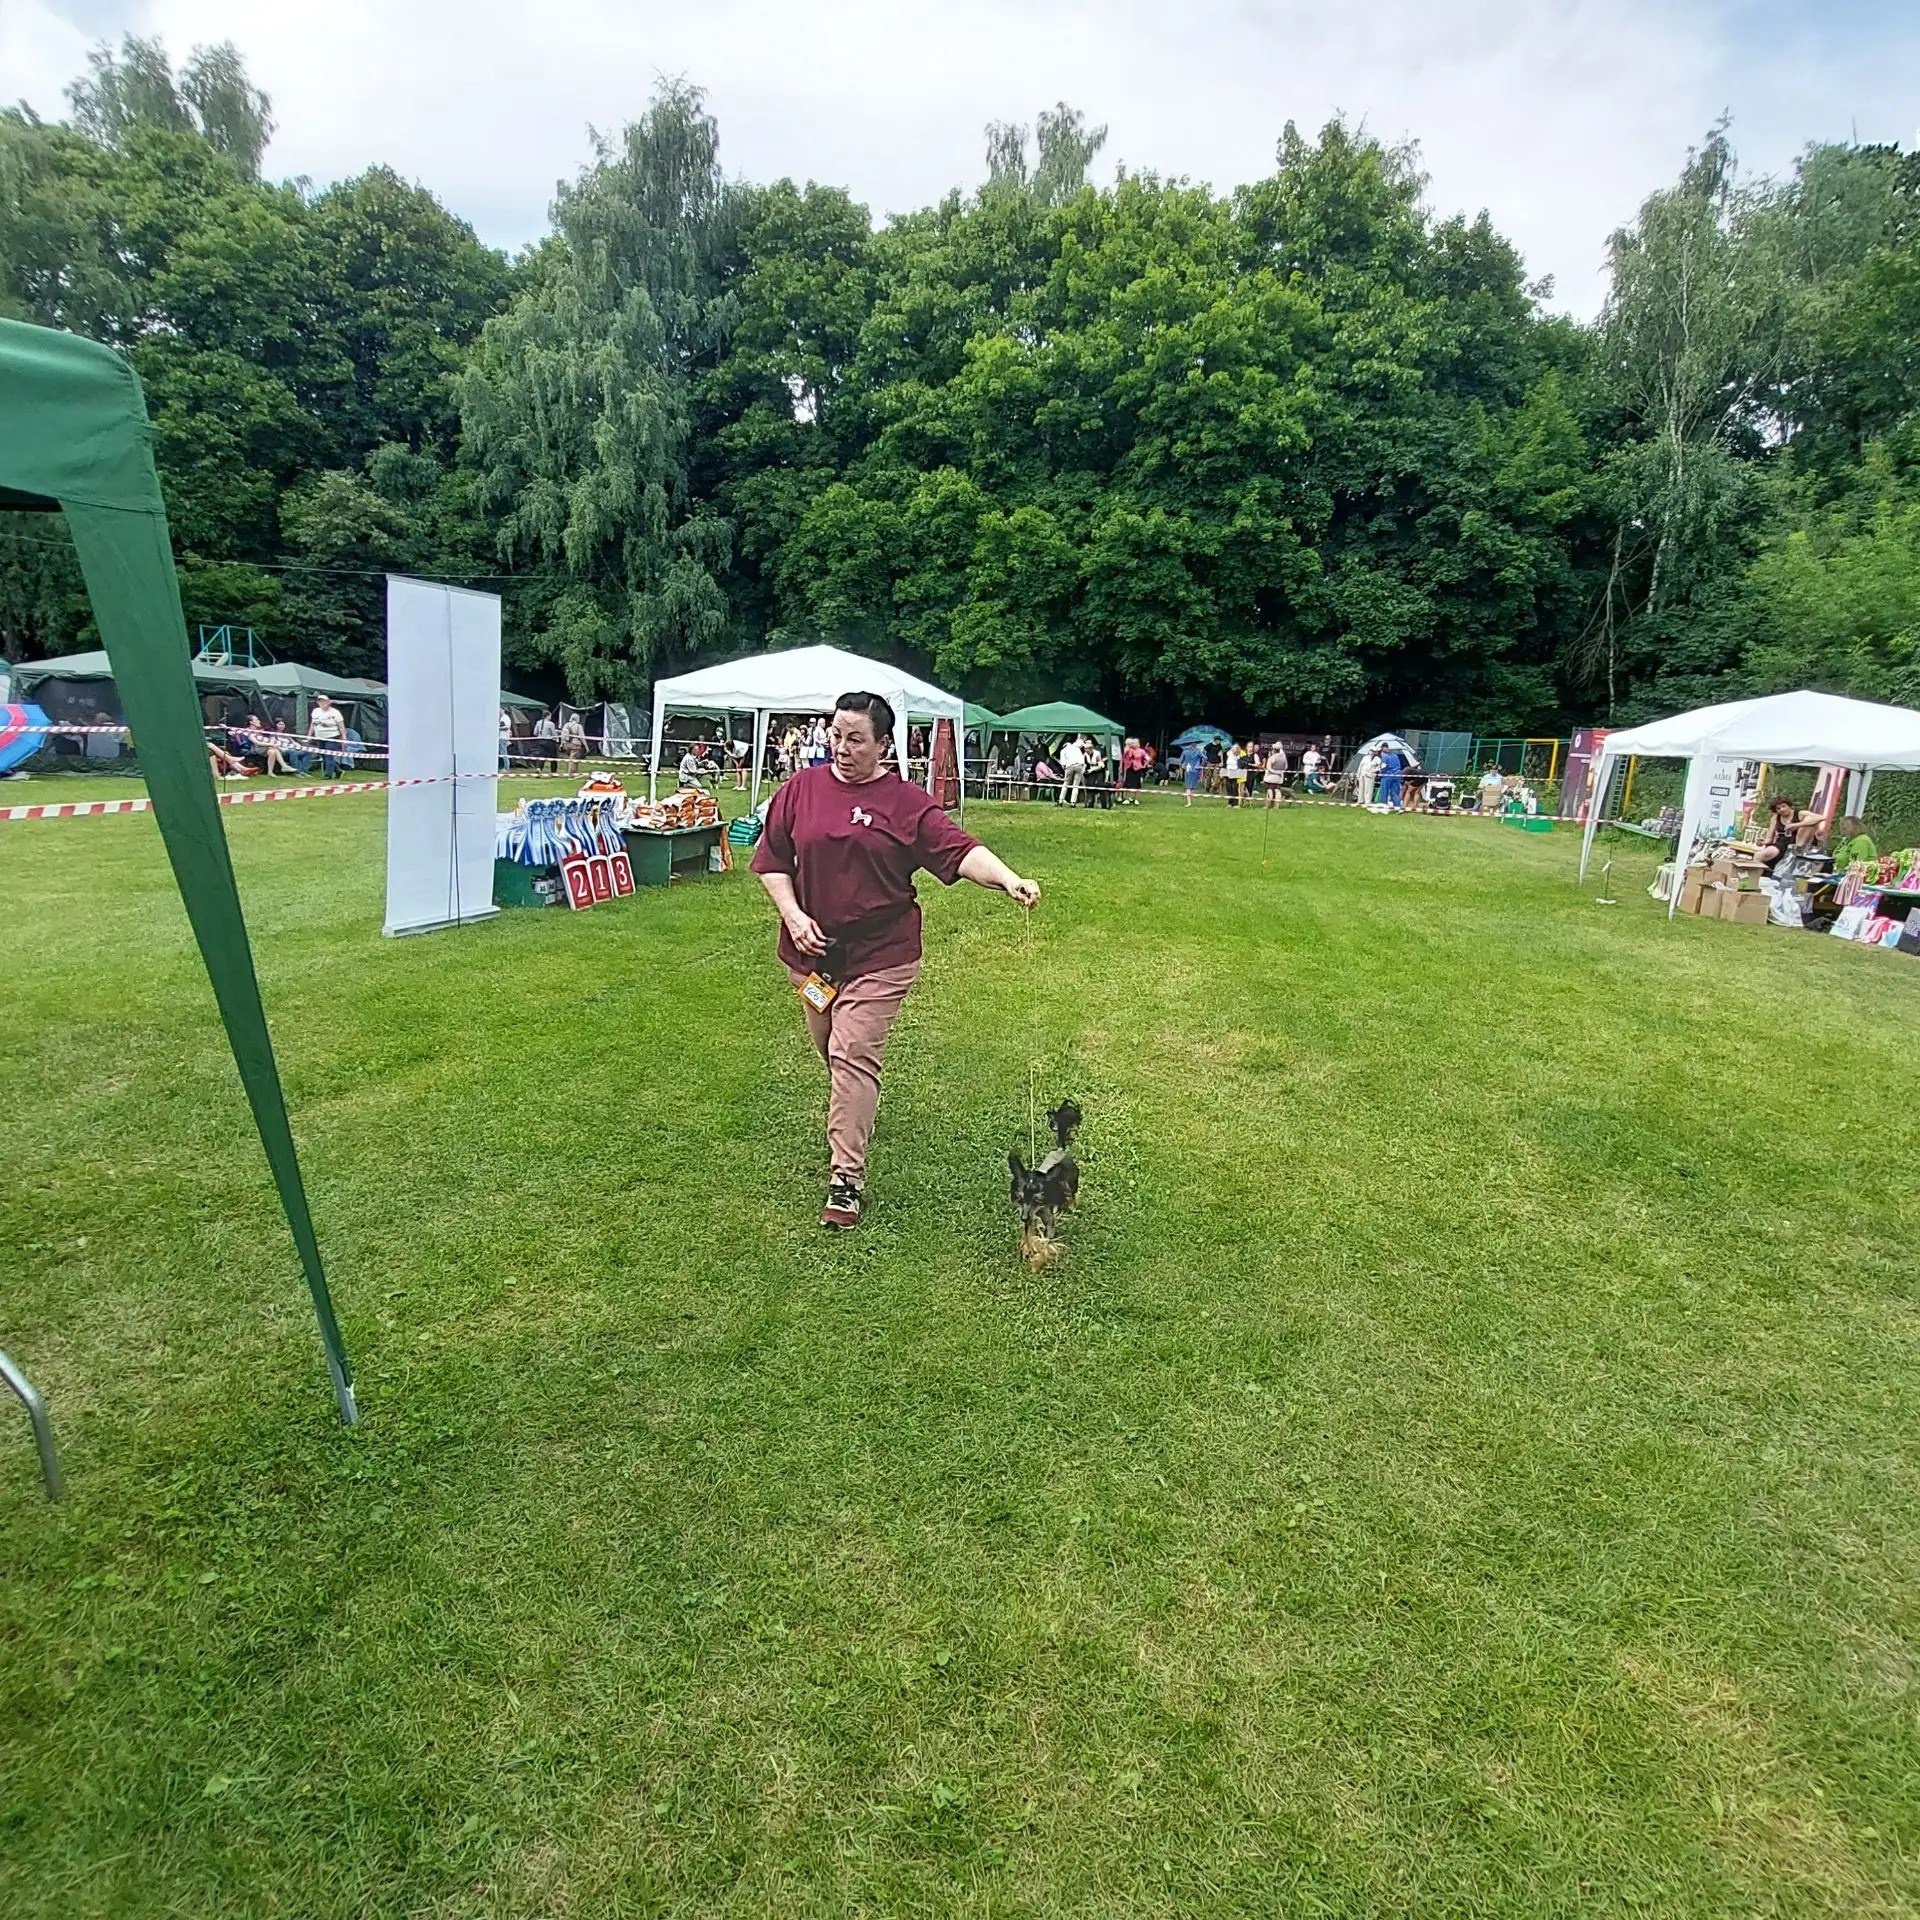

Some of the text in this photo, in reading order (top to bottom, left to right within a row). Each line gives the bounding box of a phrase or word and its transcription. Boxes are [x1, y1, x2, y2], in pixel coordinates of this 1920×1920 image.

[572, 870, 588, 898] 2
[595, 864, 606, 890] 1
[615, 860, 628, 886] 3
